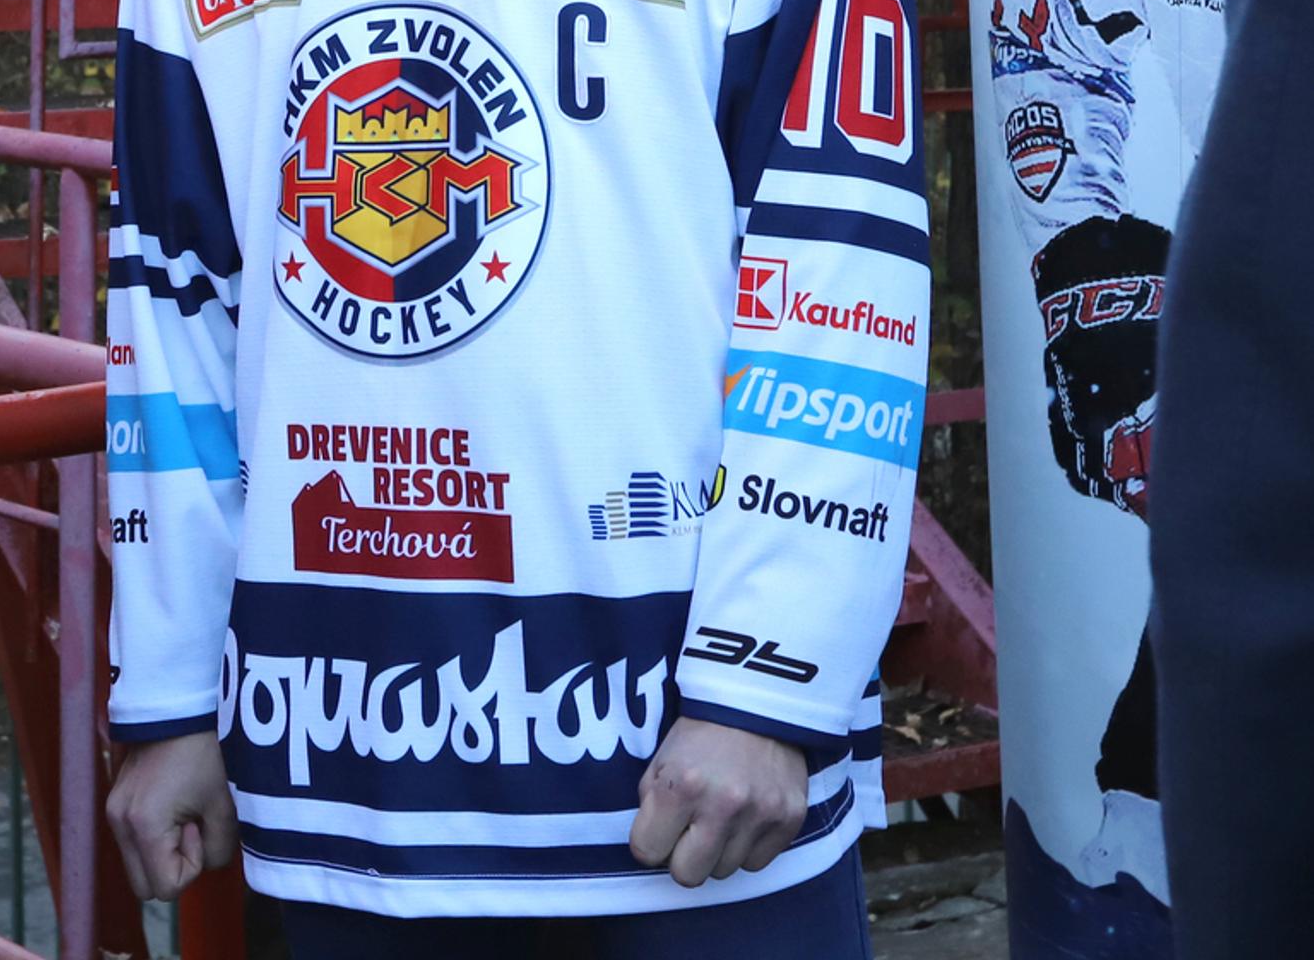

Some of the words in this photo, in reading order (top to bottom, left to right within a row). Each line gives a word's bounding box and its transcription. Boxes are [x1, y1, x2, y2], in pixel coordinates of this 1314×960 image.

[284, 33, 352, 138] HKM
[366, 17, 527, 134] ZVOLEN
[557, 1, 608, 122] C
[280, 144, 522, 228] HKM
[311, 278, 478, 346] HOCKEY
[787, 291, 916, 347] Kaufland
[738, 364, 914, 447] Tipsport
[286, 424, 471, 467] DREVENICE
[372, 467, 511, 511] RESORT
[738, 473, 890, 543] Slovnaft
[320, 515, 477, 560] Terchová
